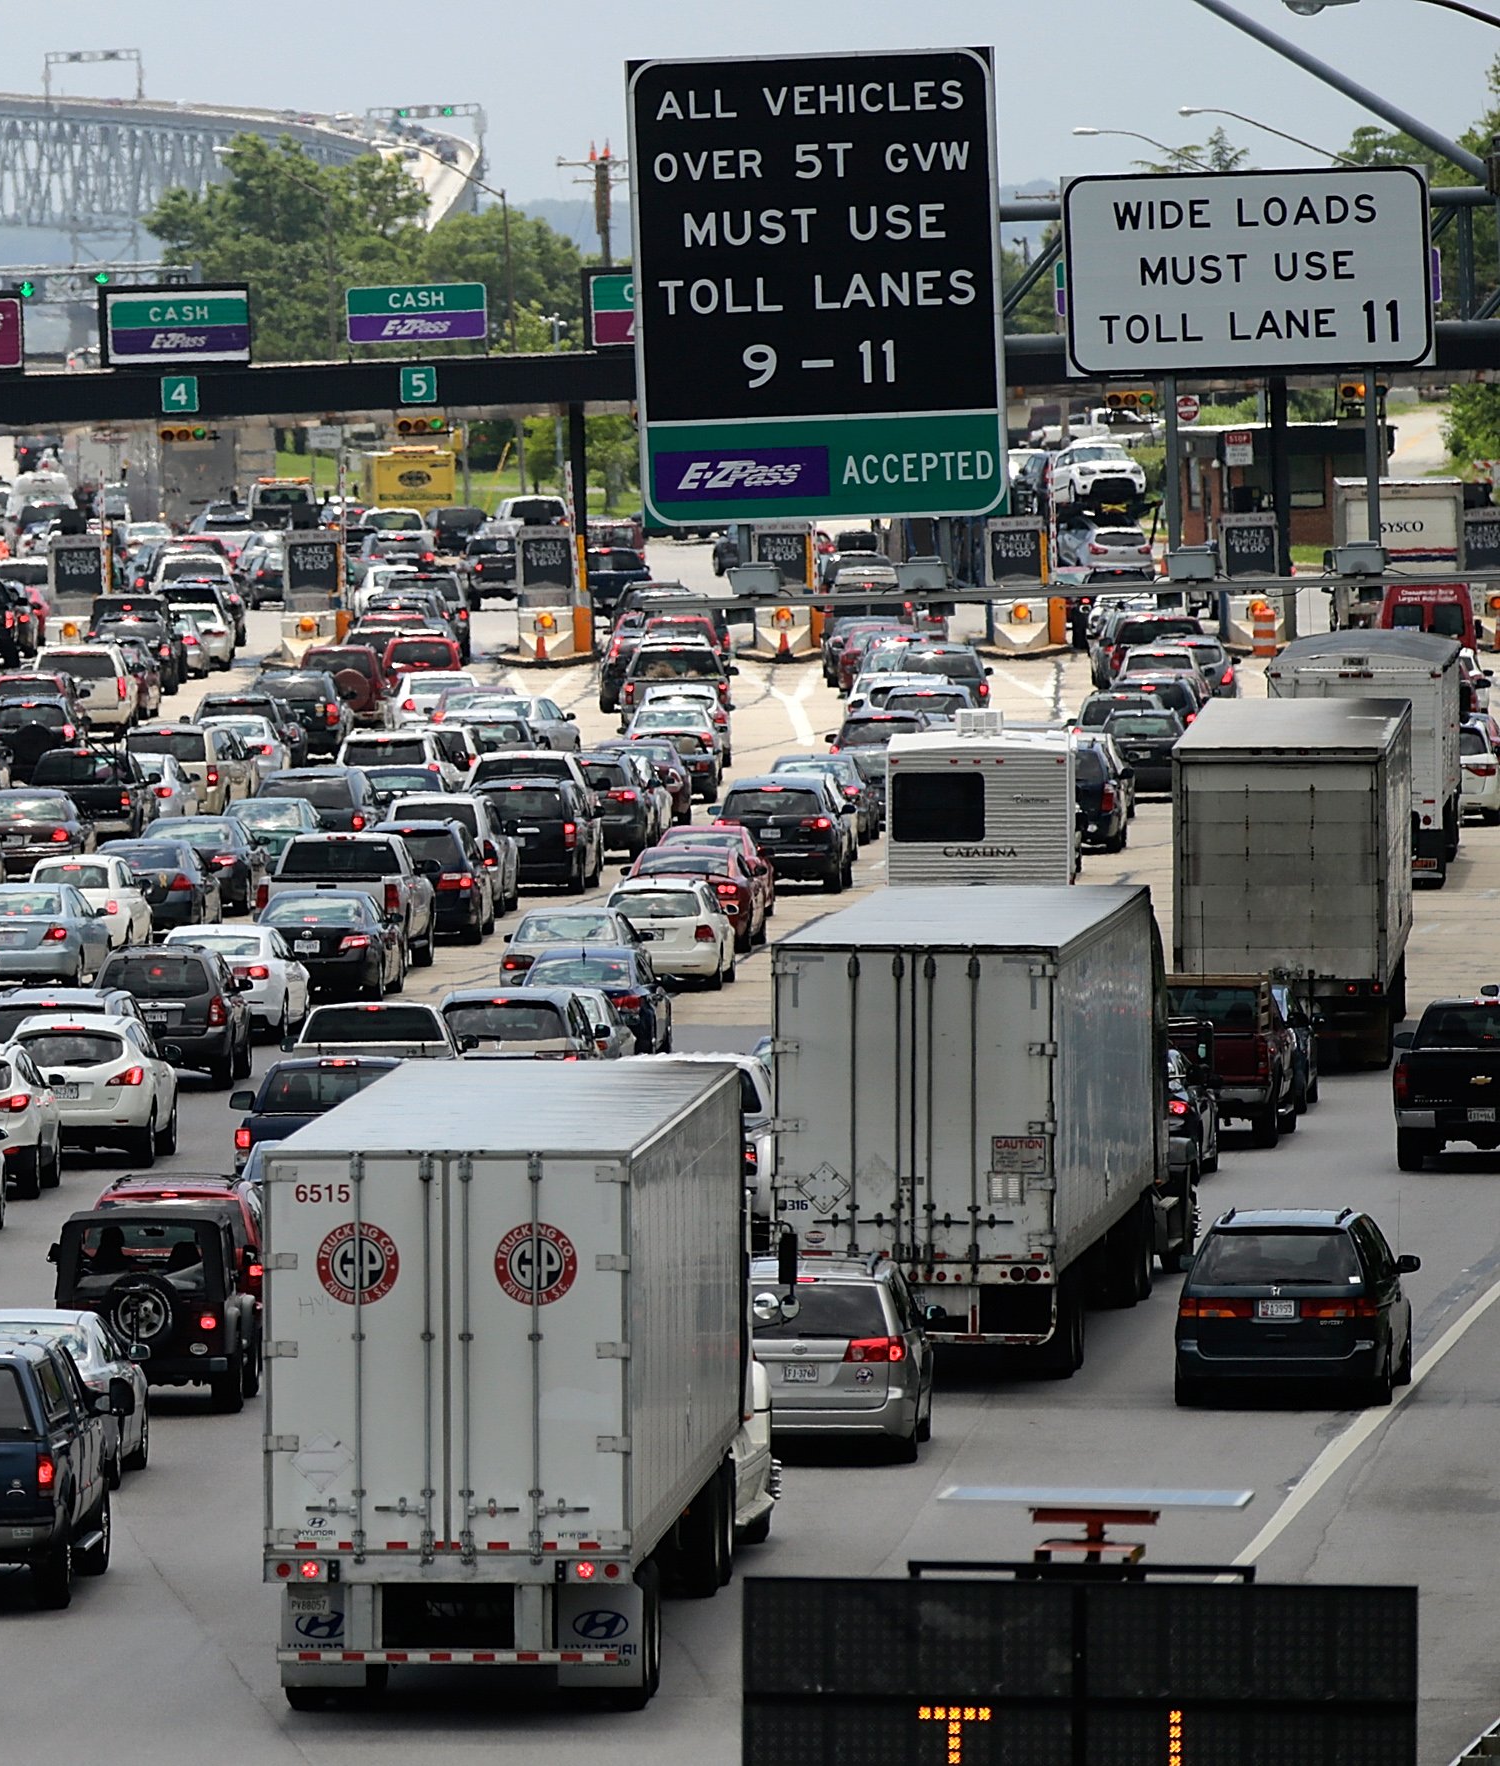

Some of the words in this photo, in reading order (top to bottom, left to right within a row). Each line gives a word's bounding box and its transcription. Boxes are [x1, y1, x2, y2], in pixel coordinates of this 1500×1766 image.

[657, 90, 736, 120] ALL
[763, 81, 963, 115] VEHICLES
[655, 150, 762, 182] OVER
[796, 143, 852, 178] 5T
[886, 142, 969, 172] GVW
[684, 209, 816, 247] MUST
[850, 204, 945, 240] USE
[1113, 200, 1210, 230] WIDE
[1237, 194, 1376, 227] LOADS
[1140, 254, 1247, 287] MUST
[1275, 251, 1355, 281] USE
[388, 291, 445, 308] CASH
[659, 278, 783, 314] TOLL
[815, 270, 975, 309] LANES
[149, 305, 209, 321] CASH
[1099, 313, 1203, 345] TOLL
[1230, 309, 1336, 341] LANE
[1363, 300, 1400, 343] 11
[743, 345, 777, 388] 9
[859, 340, 895, 383] 11
[171, 383, 188, 405] 4
[412, 373, 427, 397] 5
[677, 460, 802, 490] E-ZPass
[842, 450, 994, 485] ACCEPTED
[1380, 521, 1424, 533] SYSCO
[996, 1140, 1043, 1149] CAUTION
[295, 1184, 350, 1203] 6515
[319, 1224, 379, 1259] TRUCKNG
[496, 1225, 557, 1259] TRUCKNG
